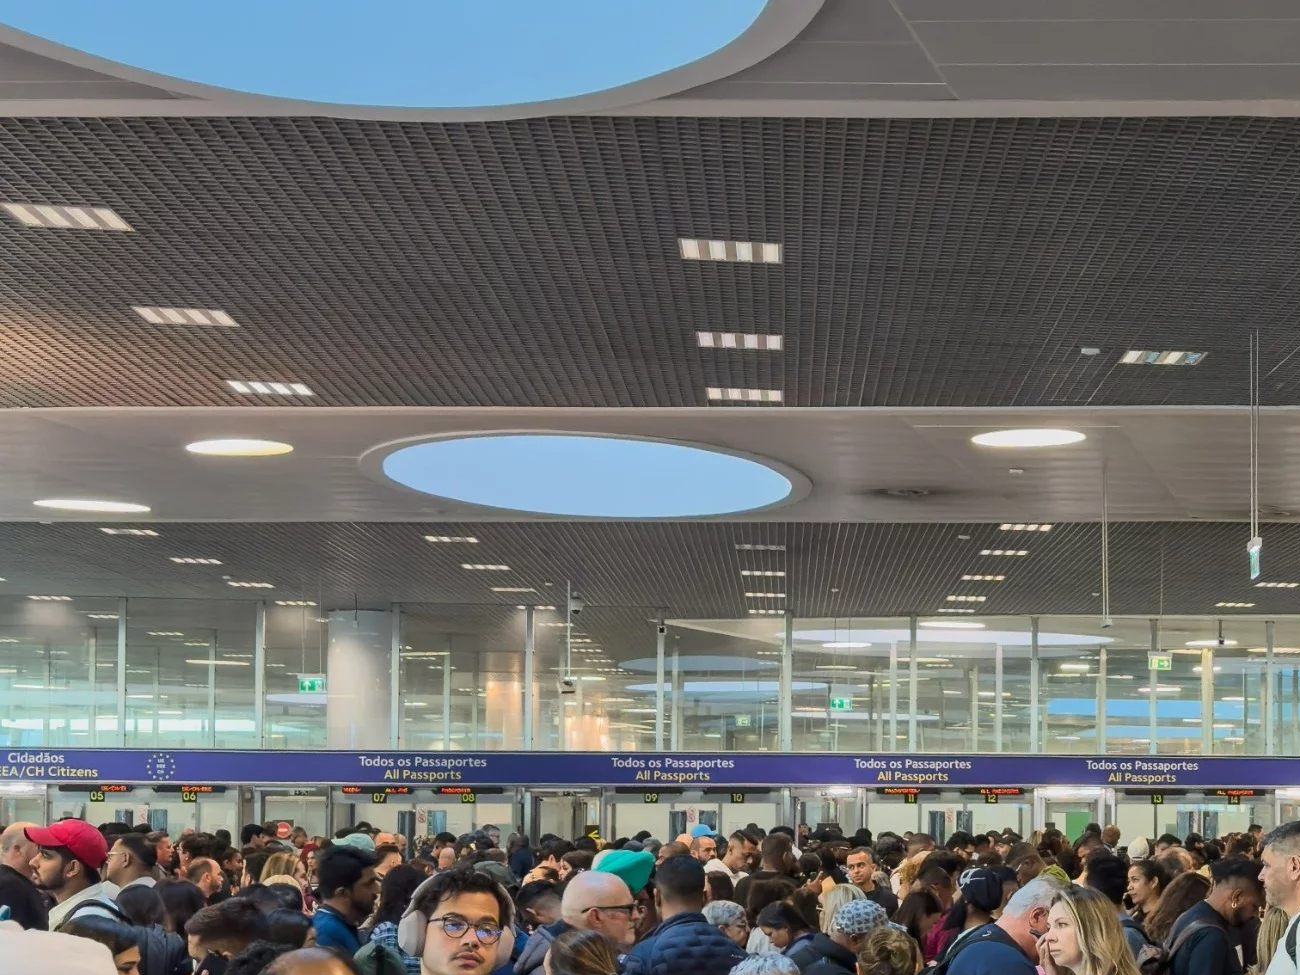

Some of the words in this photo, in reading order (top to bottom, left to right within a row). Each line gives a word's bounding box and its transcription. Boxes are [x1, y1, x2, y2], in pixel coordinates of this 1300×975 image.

[8, 752, 65, 764] Cidadãos
[358, 756, 394, 767] Todos
[397, 758, 411, 767] os
[414, 756, 487, 769] Passaportes
[611, 757, 645, 768] Todos
[648, 759, 661, 768] os
[665, 757, 734, 770] Passaportes
[855, 758, 886, 769] Todos
[890, 761, 902, 769] os
[905, 759, 972, 771] Passaportes
[1086, 760, 1117, 770] Todos
[1120, 762, 1132, 770] os
[1135, 761, 1199, 772] Passaportes
[0, 765, 45, 778] EA/CH
[48, 765, 98, 778] Citizens
[384, 769, 399, 780] All
[403, 770, 462, 782] Passports
[636, 770, 650, 780] All
[653, 771, 710, 783] Passports
[877, 772, 891, 781] All
[895, 772, 949, 783] Passports
[1108, 773, 1121, 782] All
[1125, 773, 1177, 784] Passports
[90, 791, 104, 801] 05
[183, 792, 197, 801] 06
[373, 793, 386, 802] 07
[462, 793, 475, 802] 08
[645, 793, 658, 802] 09
[733, 793, 743, 802] 10
[907, 794, 915, 802] 11
[987, 794, 996, 803] 12
[1153, 795, 1162, 803] 13
